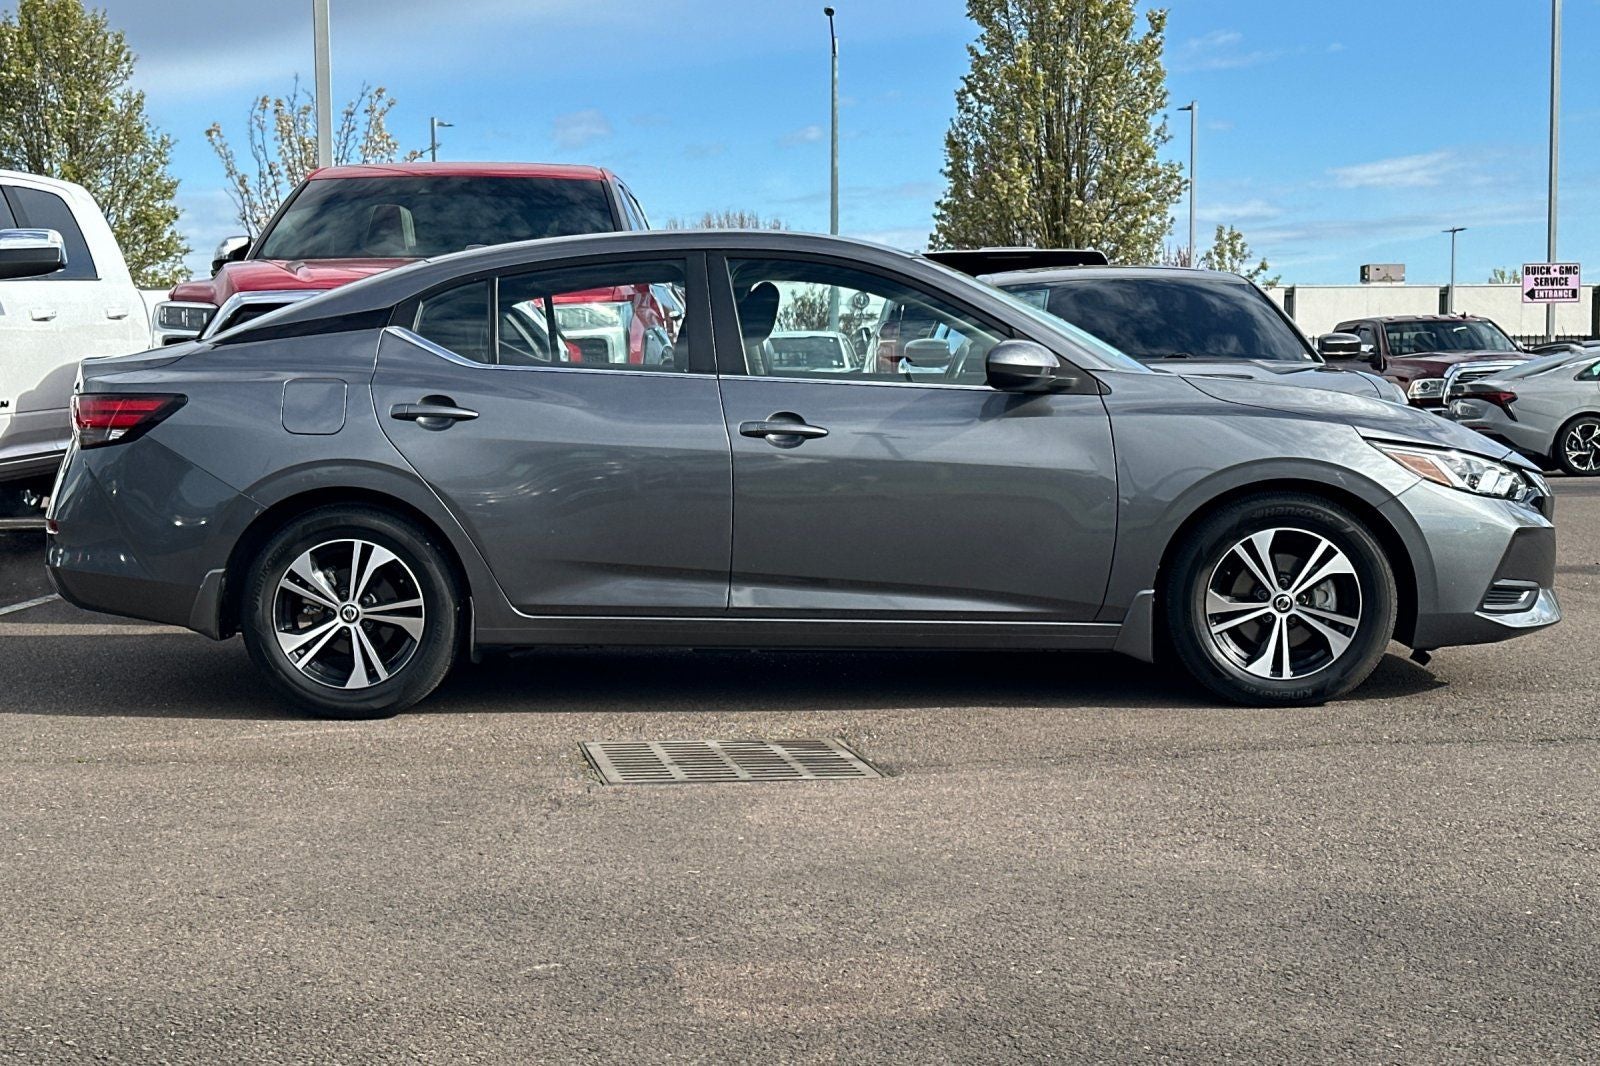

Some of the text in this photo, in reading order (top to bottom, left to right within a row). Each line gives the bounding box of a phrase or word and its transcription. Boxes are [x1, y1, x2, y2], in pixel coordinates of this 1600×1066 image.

[1525, 266, 1578, 275] BUICK GMC
[1534, 277, 1569, 286] SERVICE
[1535, 289, 1573, 298] ENTRANCE
